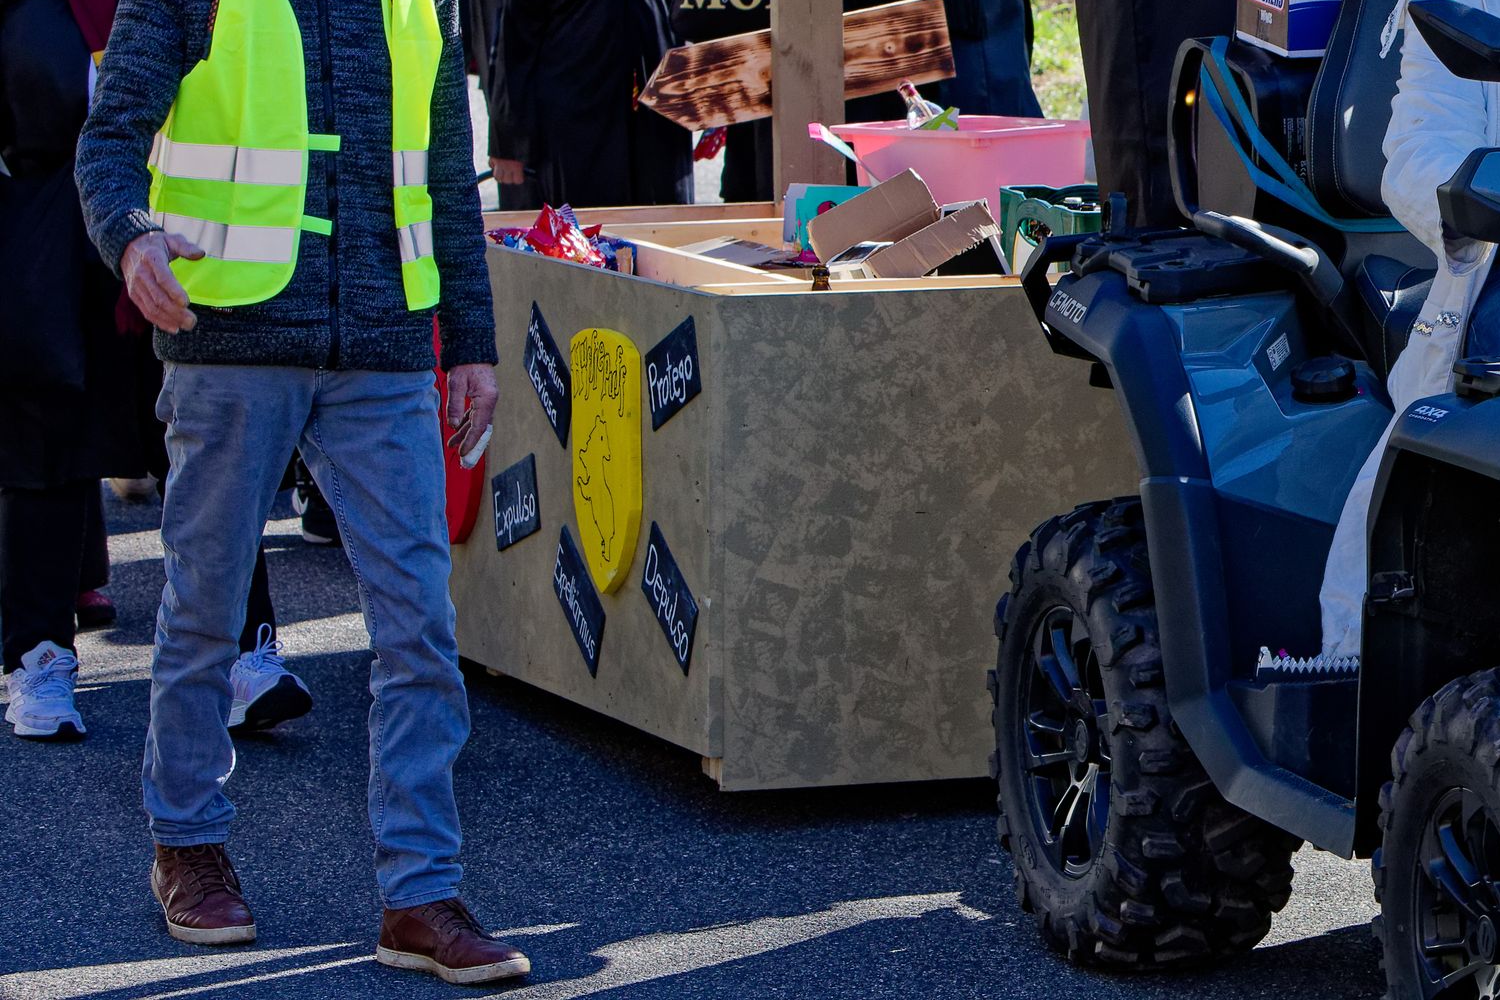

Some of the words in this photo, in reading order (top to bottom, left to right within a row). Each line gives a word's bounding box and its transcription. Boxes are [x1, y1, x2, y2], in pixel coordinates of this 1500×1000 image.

[1049, 289, 1088, 324] CFMOTO
[529, 353, 558, 428] Leviosa
[647, 352, 694, 413] Protego
[494, 480, 536, 544] Expulso
[553, 543, 597, 660] Expelliarmus
[644, 543, 690, 662] Depulso
